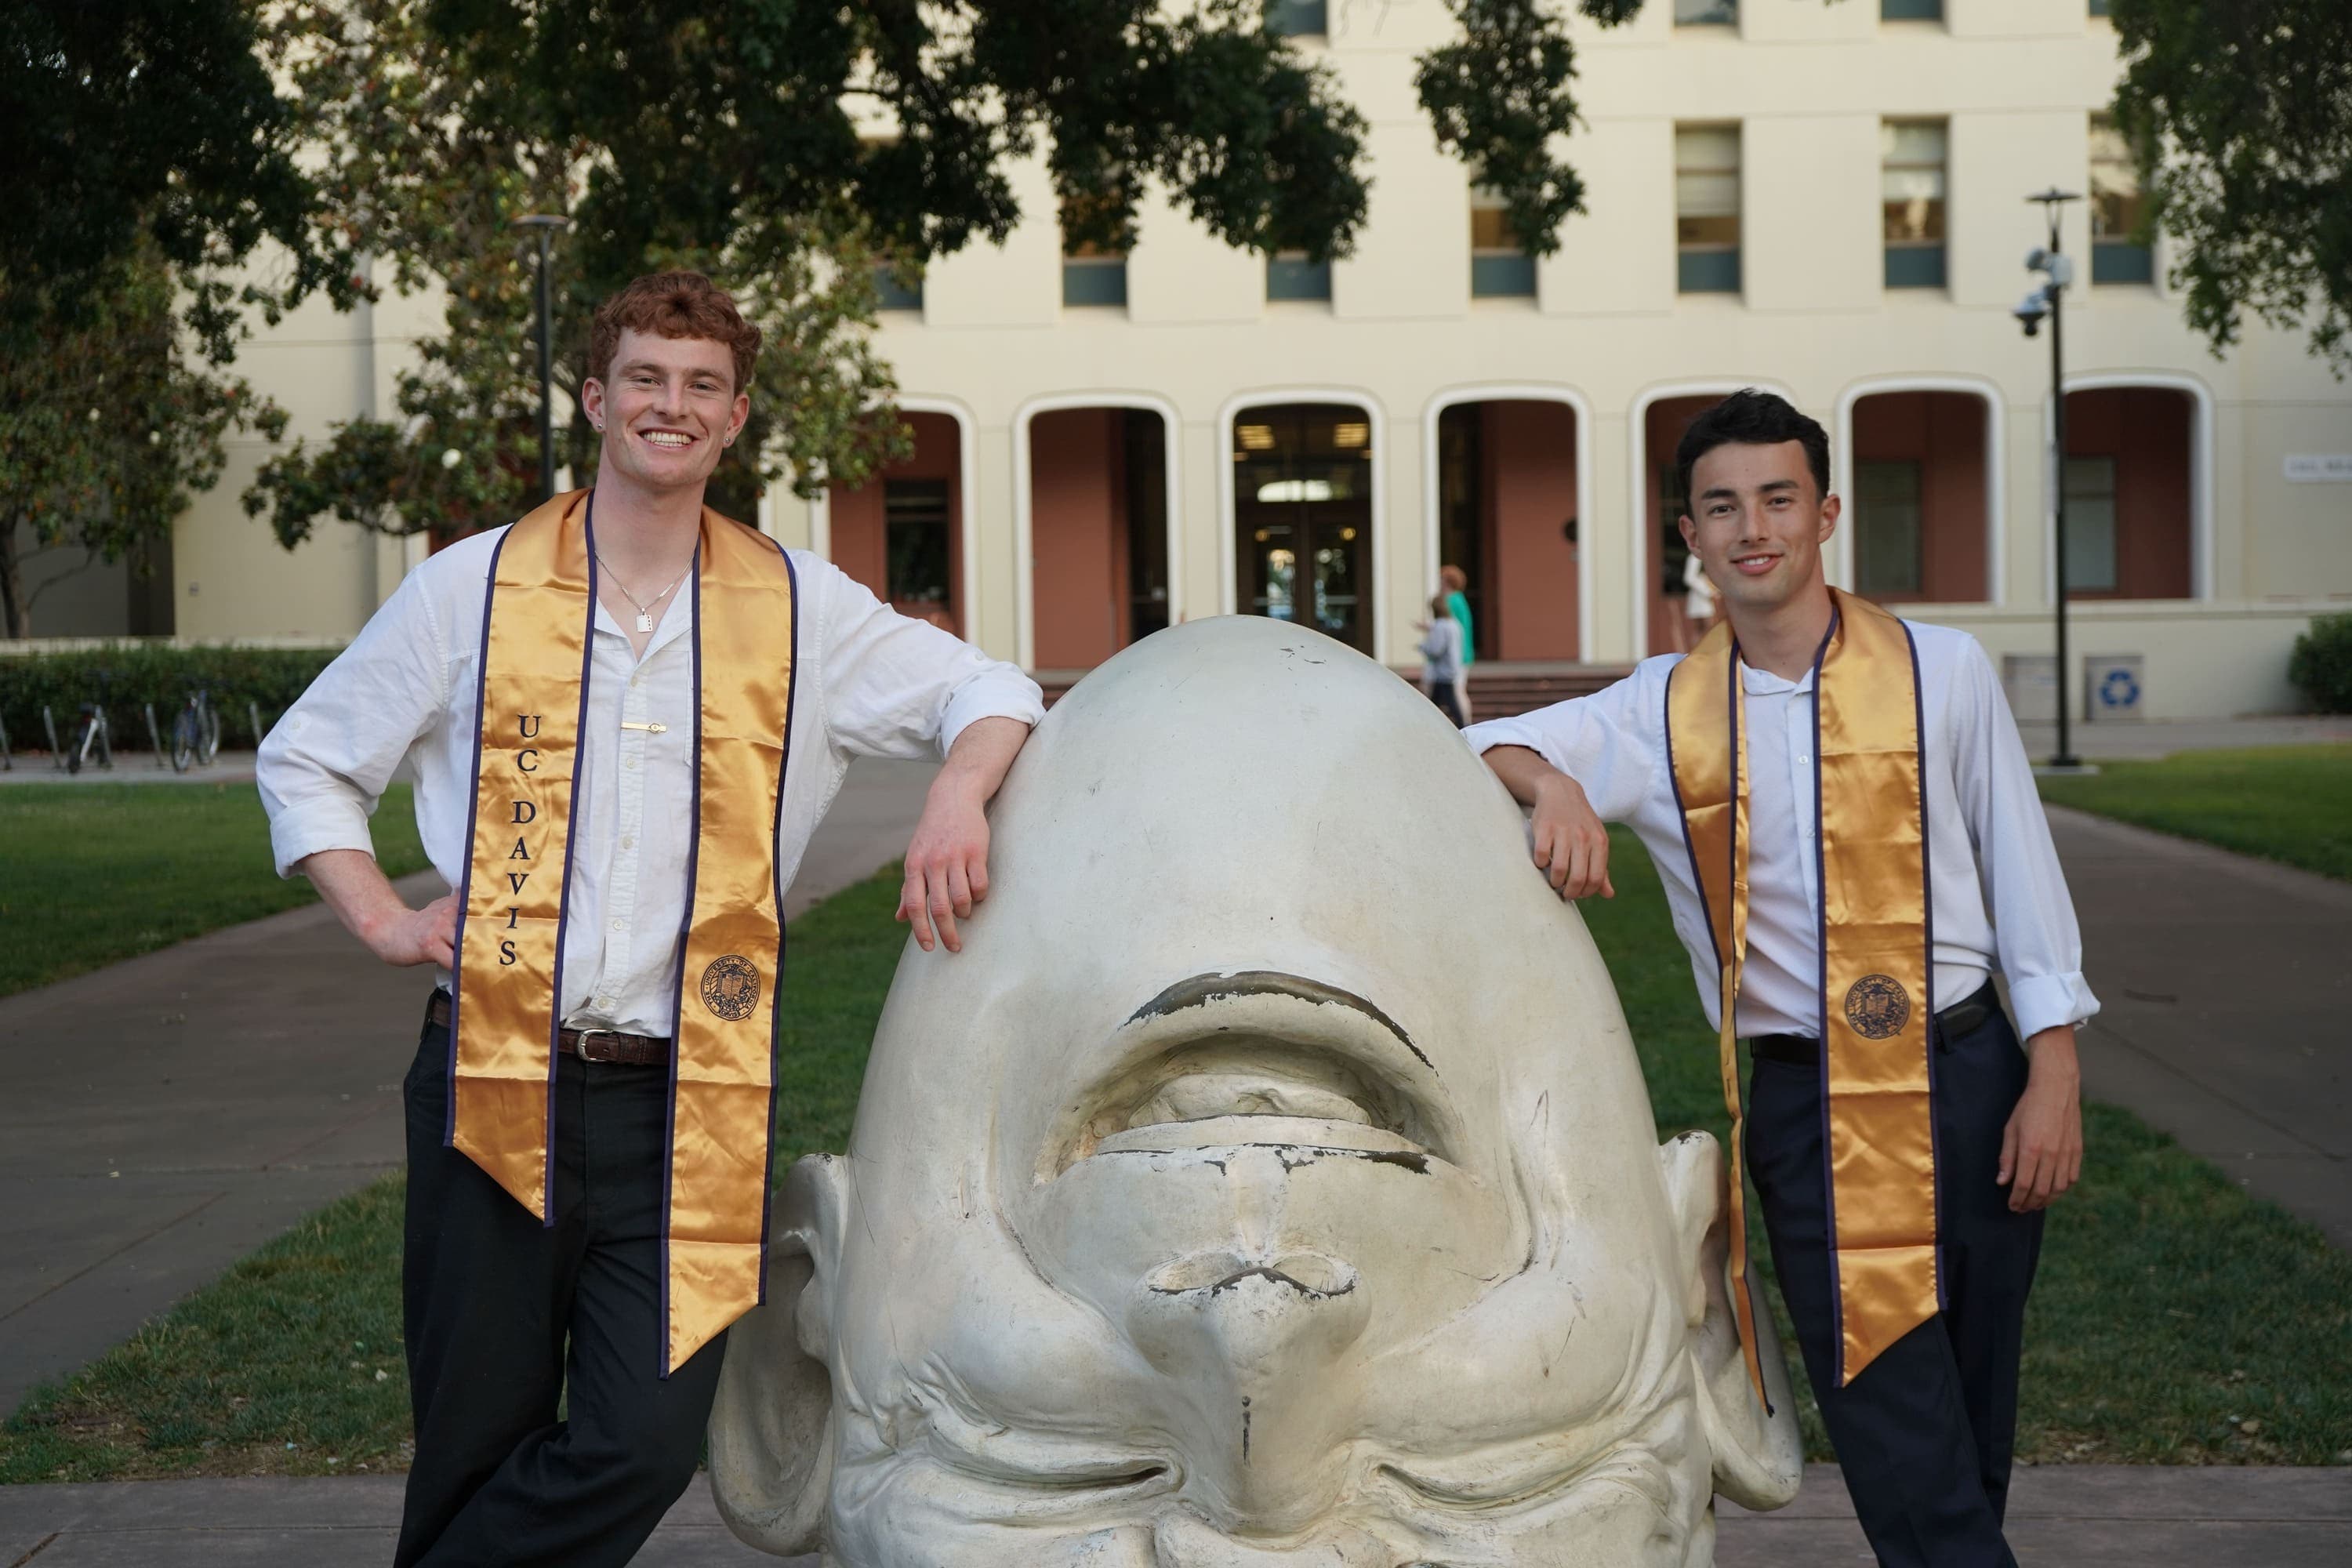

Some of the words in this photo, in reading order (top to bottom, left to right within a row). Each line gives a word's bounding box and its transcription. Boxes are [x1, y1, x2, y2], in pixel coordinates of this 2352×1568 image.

[517, 714, 541, 772] UC
[499, 800, 537, 966] DAVIS
[706, 959, 735, 985] UNIVERSITY
[705, 991, 713, 1004] THE
